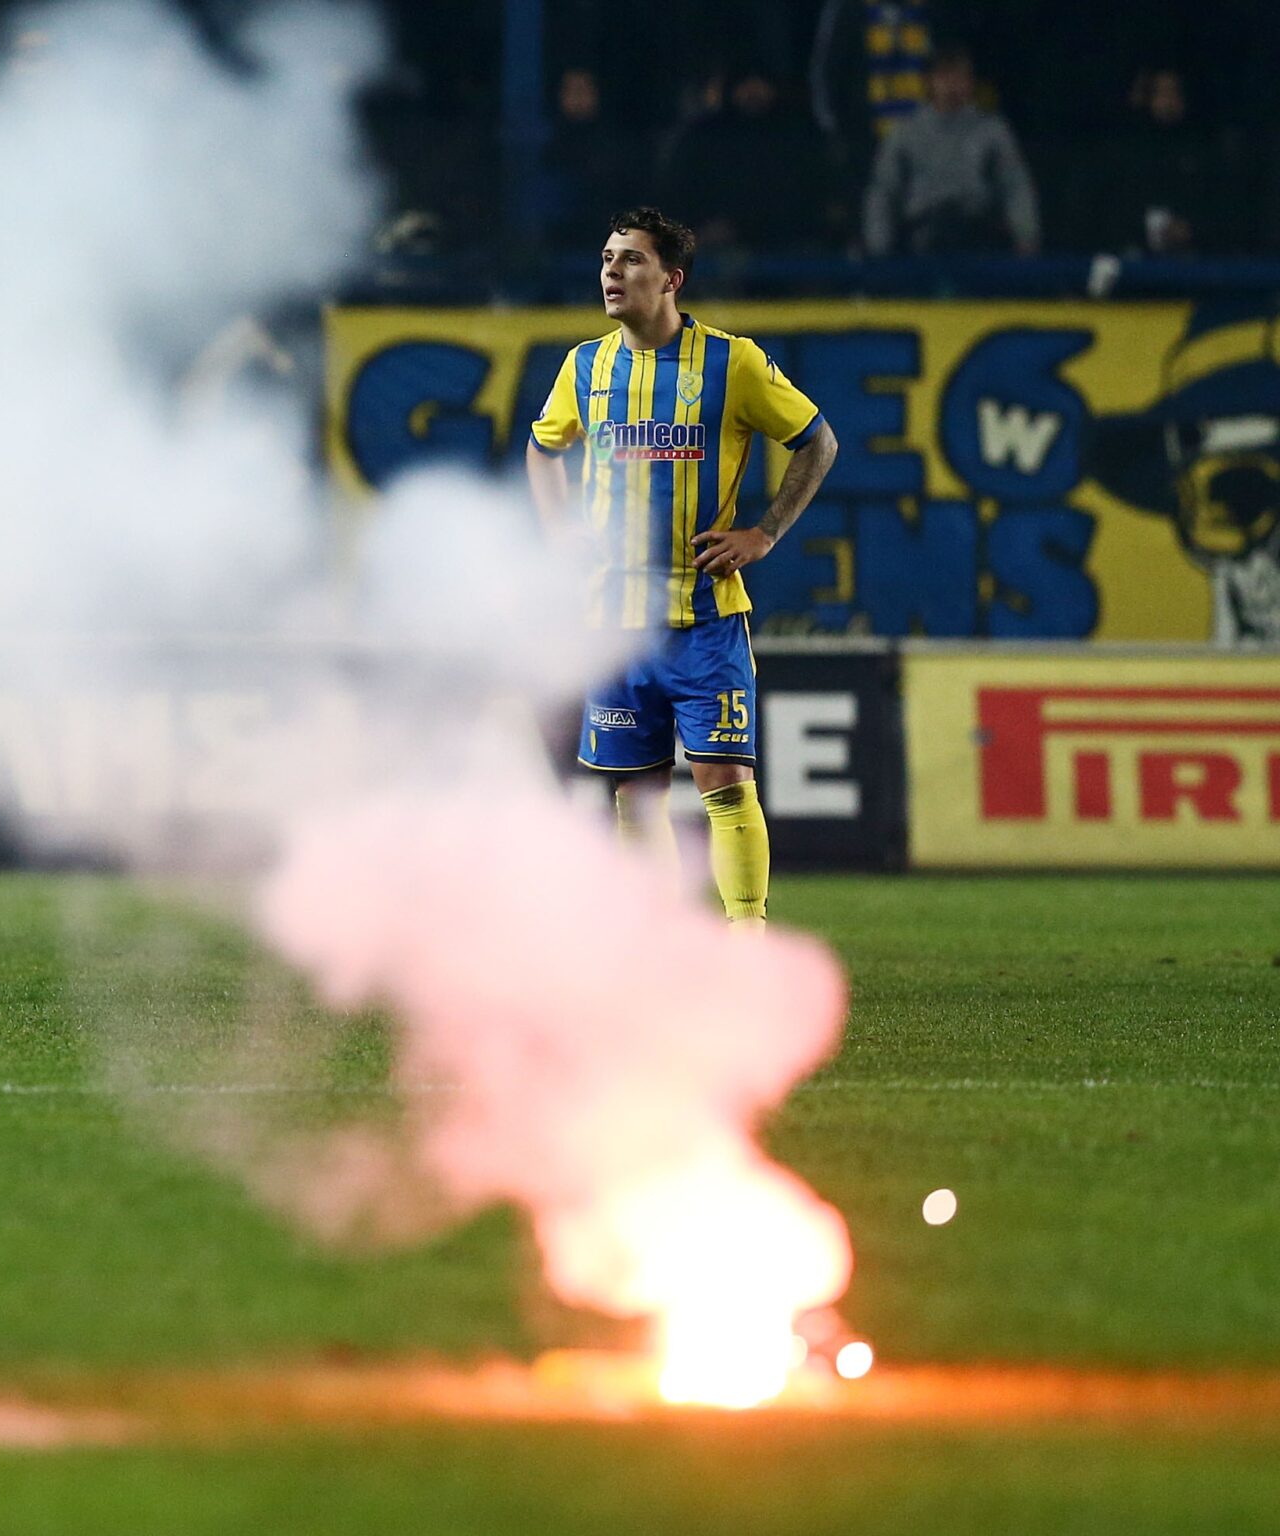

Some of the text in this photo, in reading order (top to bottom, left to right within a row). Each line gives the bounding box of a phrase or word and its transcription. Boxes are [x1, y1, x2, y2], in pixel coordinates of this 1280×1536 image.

[595, 419, 705, 448] Emileon
[716, 690, 748, 730] 15
[707, 730, 749, 744] Zeus
[976, 686, 1280, 822] PIR
